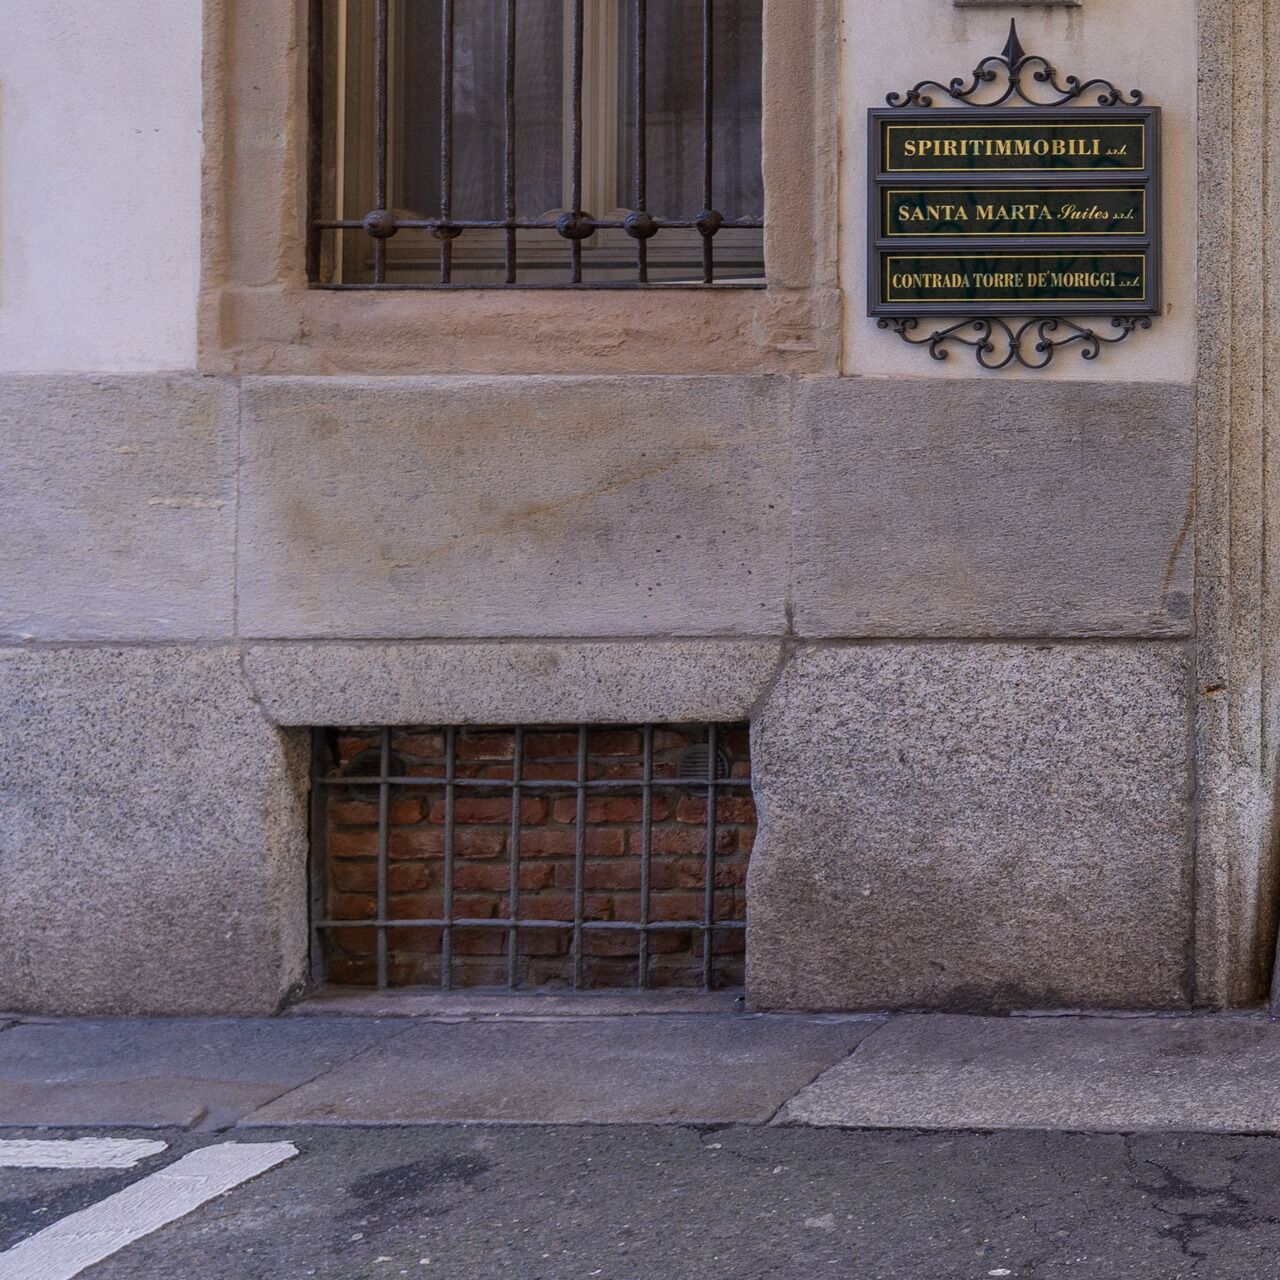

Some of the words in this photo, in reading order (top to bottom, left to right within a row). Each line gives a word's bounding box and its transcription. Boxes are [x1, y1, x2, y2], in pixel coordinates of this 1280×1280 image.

[904, 139, 1101, 156] SPIRITIMMOBILI
[1106, 144, 1127, 156] s.r.l.
[898, 205, 968, 221] SANTA
[976, 204, 1052, 220] MARTA
[1057, 204, 1109, 219] Suites
[1113, 208, 1134, 220] s.r.l.
[892, 273, 970, 289] CONTRADA
[973, 273, 1023, 288] TORRE
